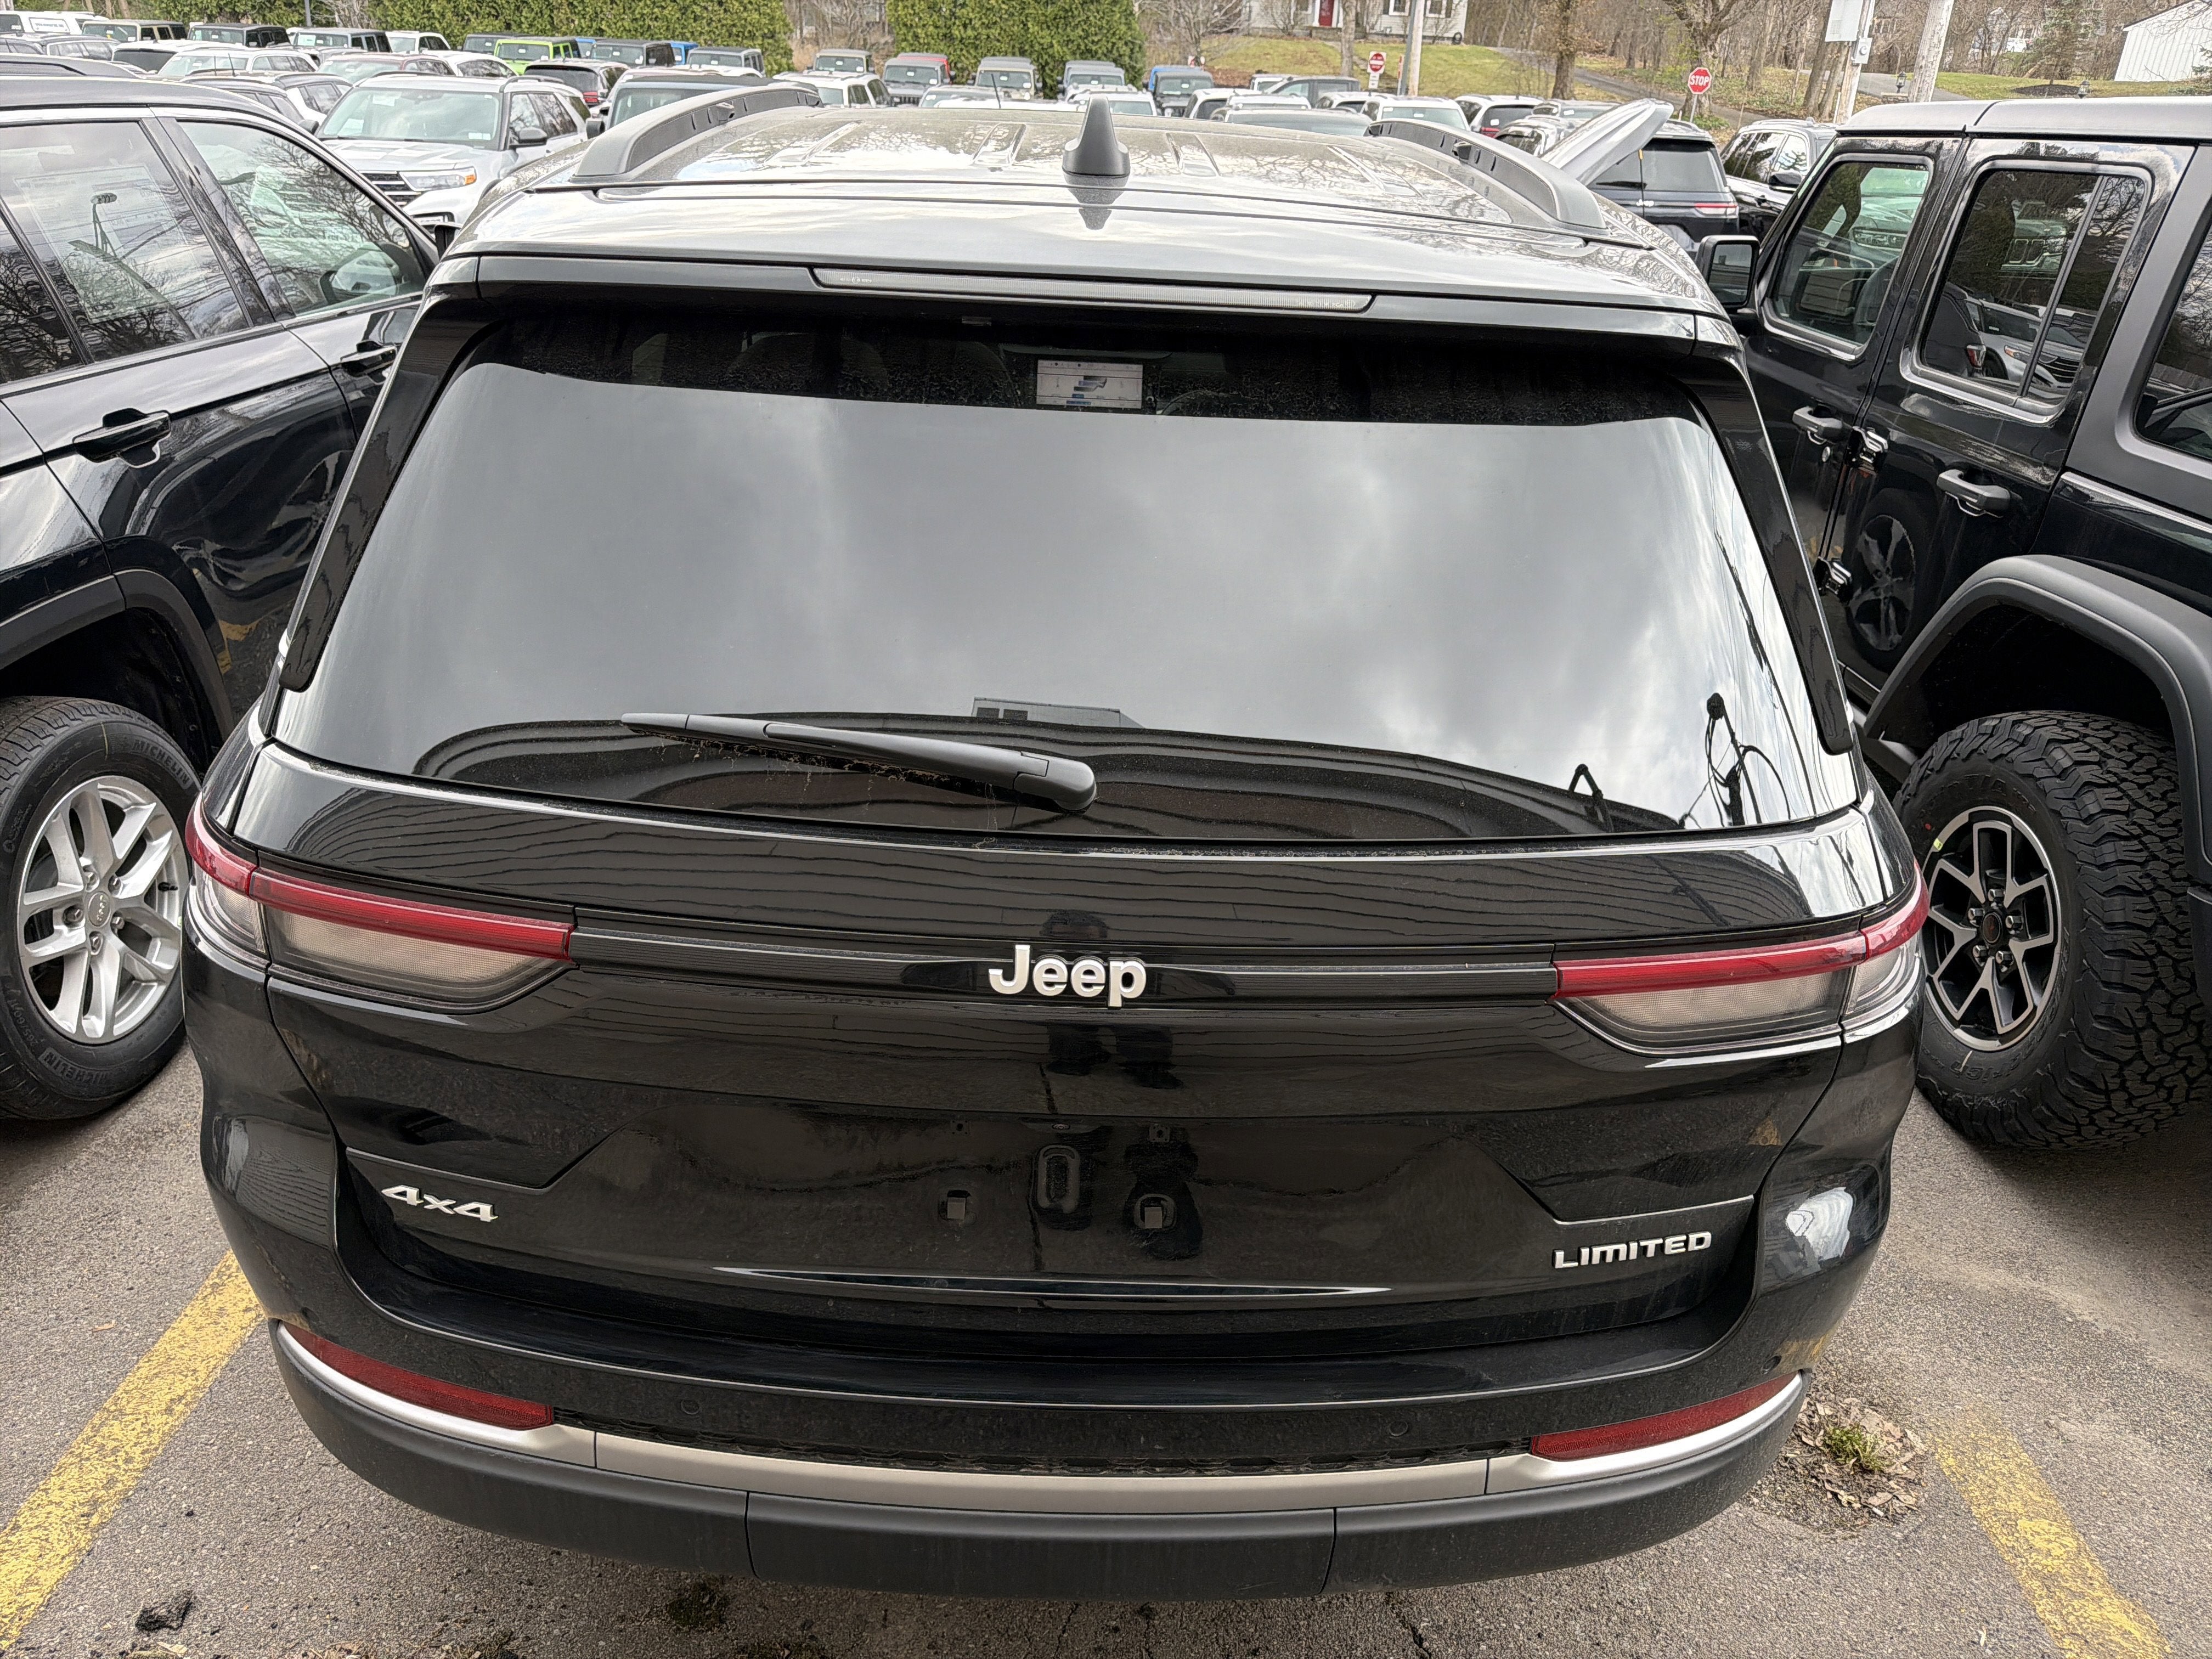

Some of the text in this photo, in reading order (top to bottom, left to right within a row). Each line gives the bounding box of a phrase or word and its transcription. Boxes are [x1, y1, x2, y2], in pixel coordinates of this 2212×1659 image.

[1690, 75, 1709, 86] STOP
[133, 739, 191, 785] MICHELIN
[988, 944, 1147, 1007] Jeep
[381, 1184, 498, 1222] 4x4
[1553, 1231, 1712, 1269] LIMITED
